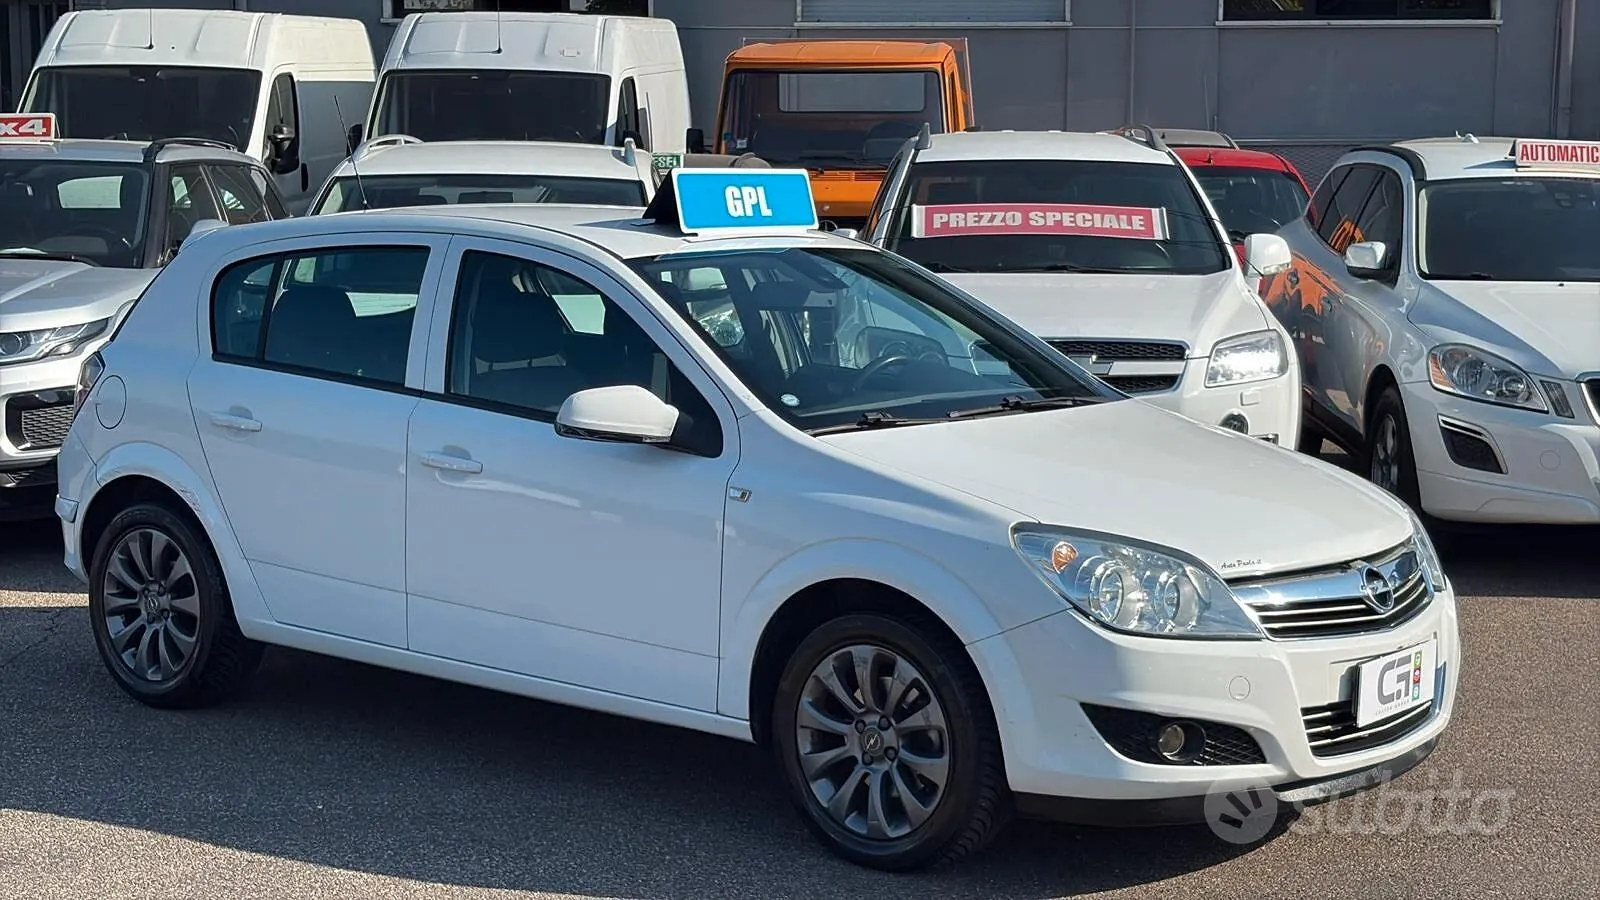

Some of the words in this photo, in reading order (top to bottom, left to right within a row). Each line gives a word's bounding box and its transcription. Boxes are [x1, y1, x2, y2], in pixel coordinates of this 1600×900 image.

[1520, 143, 1600, 163] AUTOMATIC
[724, 185, 773, 218] GPL
[932, 211, 1023, 229] PREZZO
[1028, 211, 1145, 231] SPECIALE
